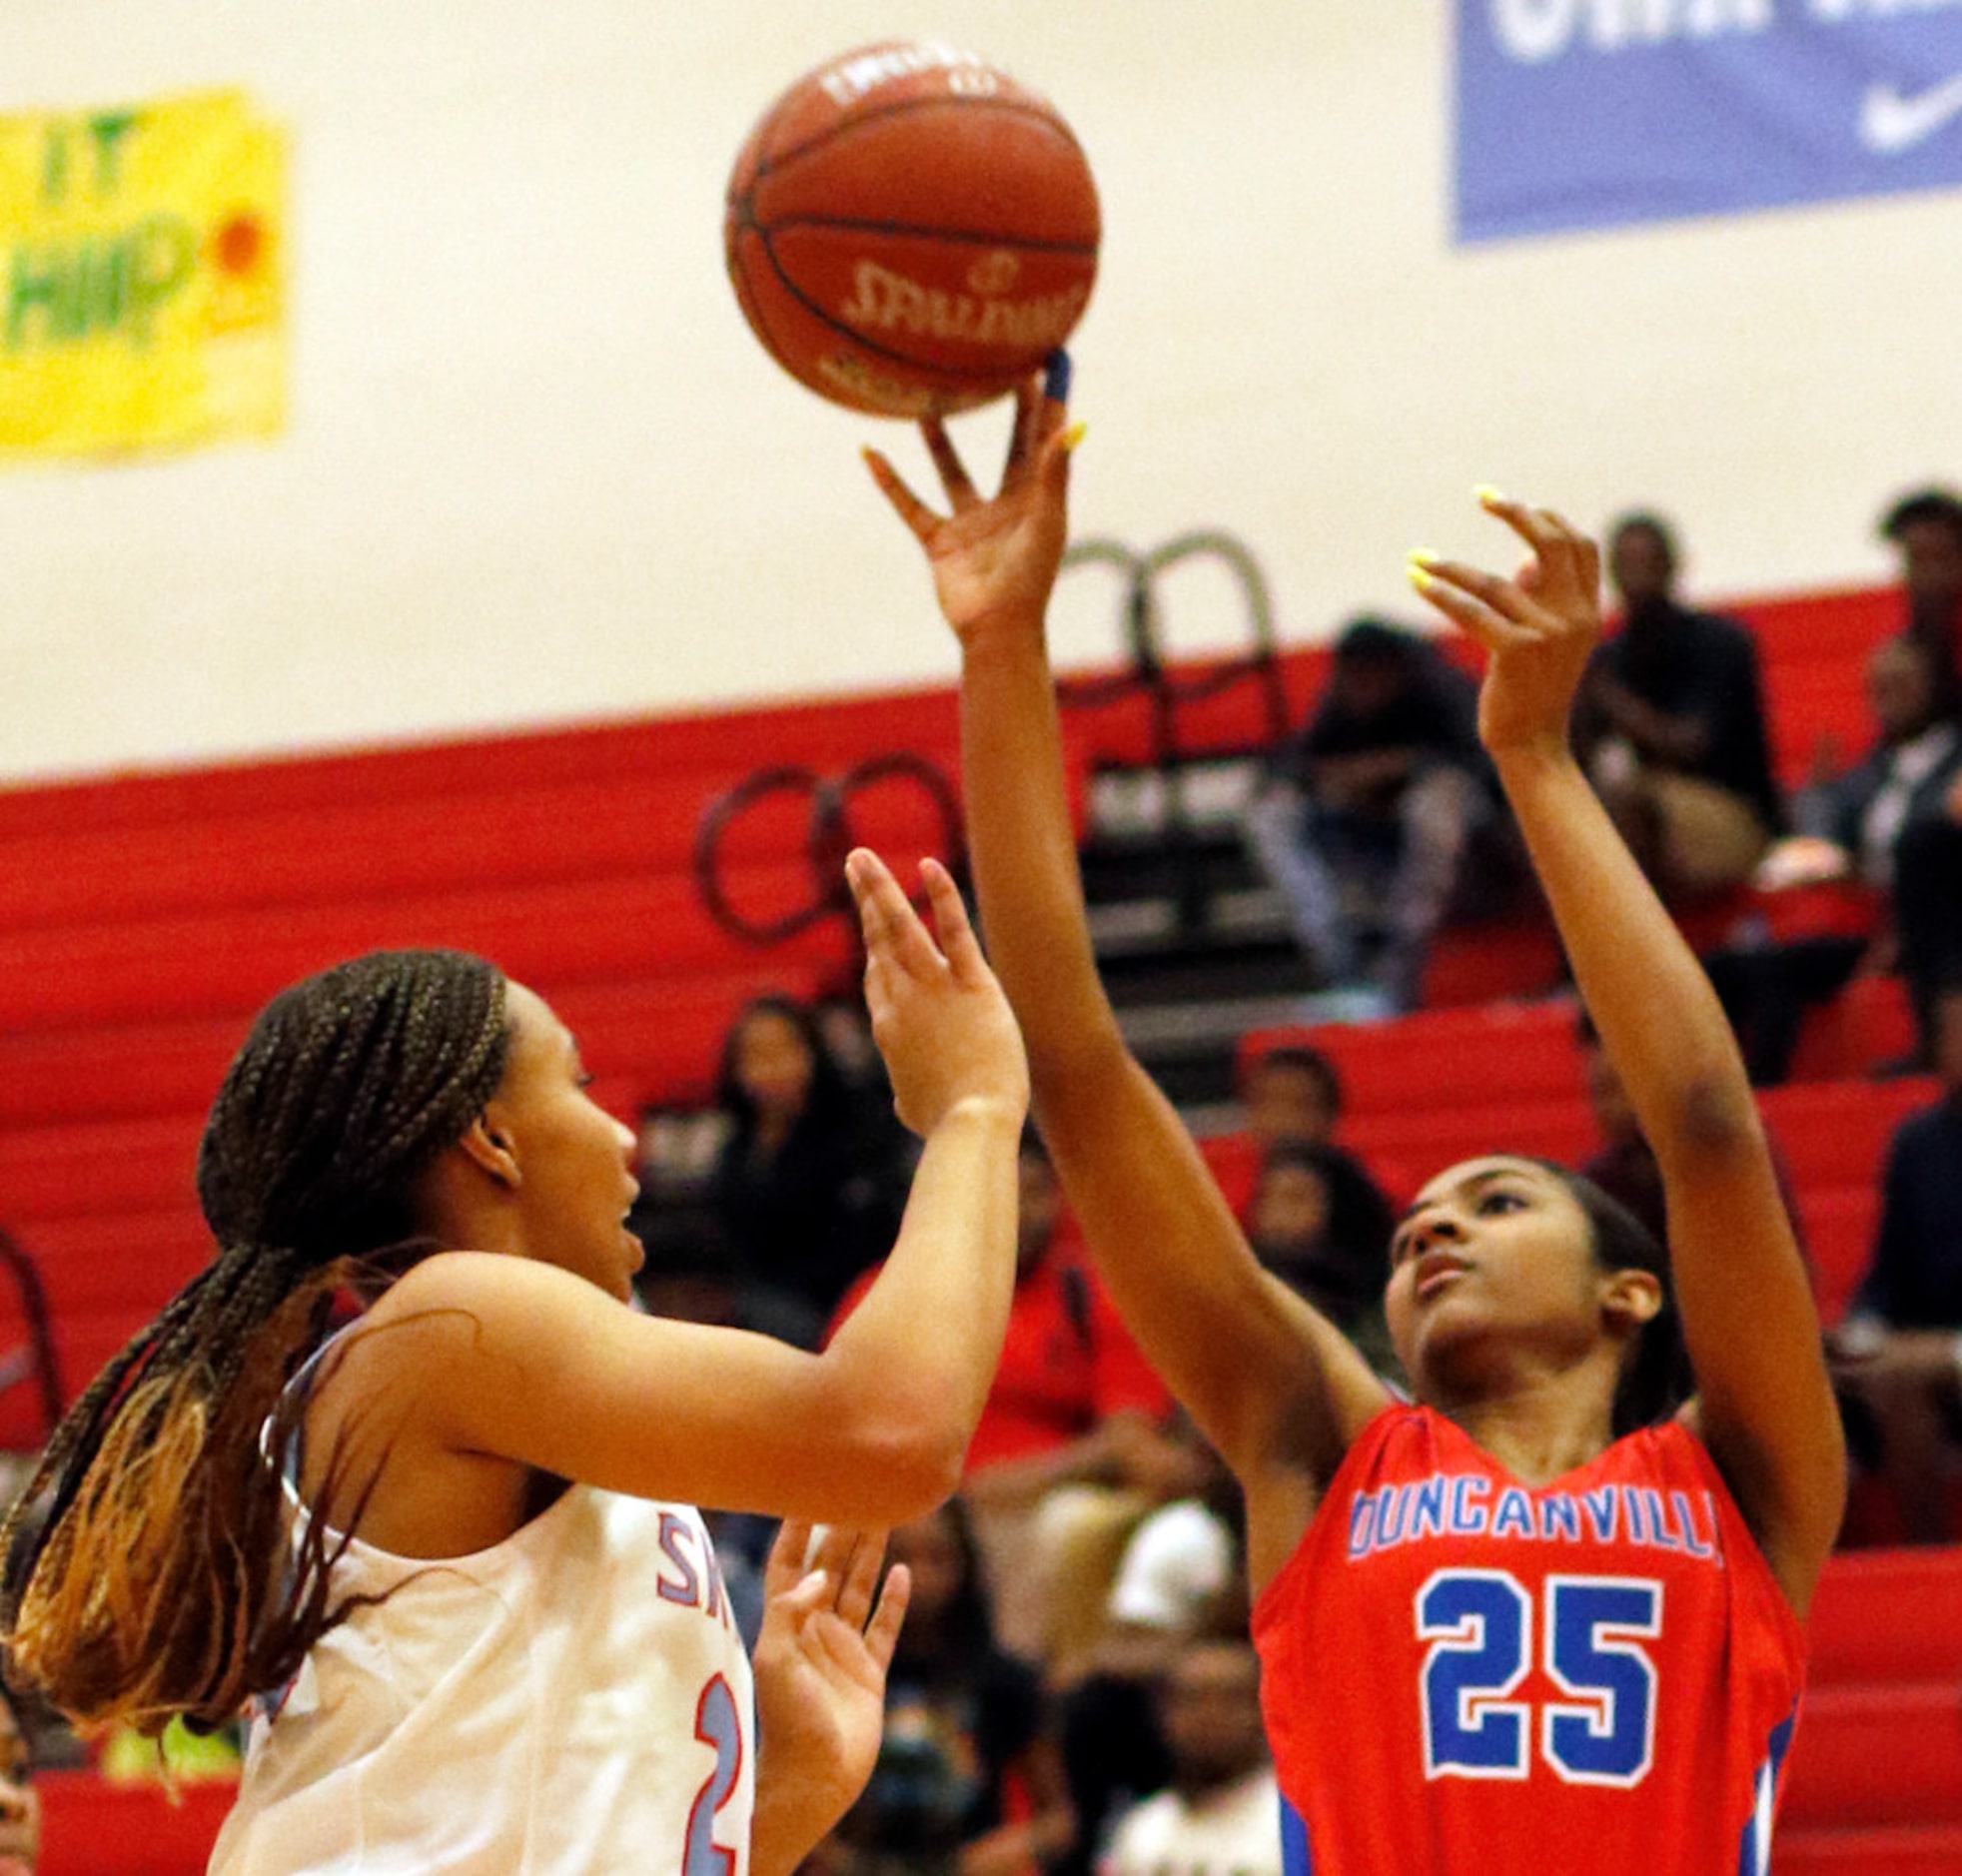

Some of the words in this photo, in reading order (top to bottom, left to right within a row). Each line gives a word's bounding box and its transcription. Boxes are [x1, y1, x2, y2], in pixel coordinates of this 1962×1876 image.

[1348, 1472, 1724, 1569] DUNCANVILL
[680, 1671, 743, 1876] 2
[1415, 1567, 1663, 1788] 25
